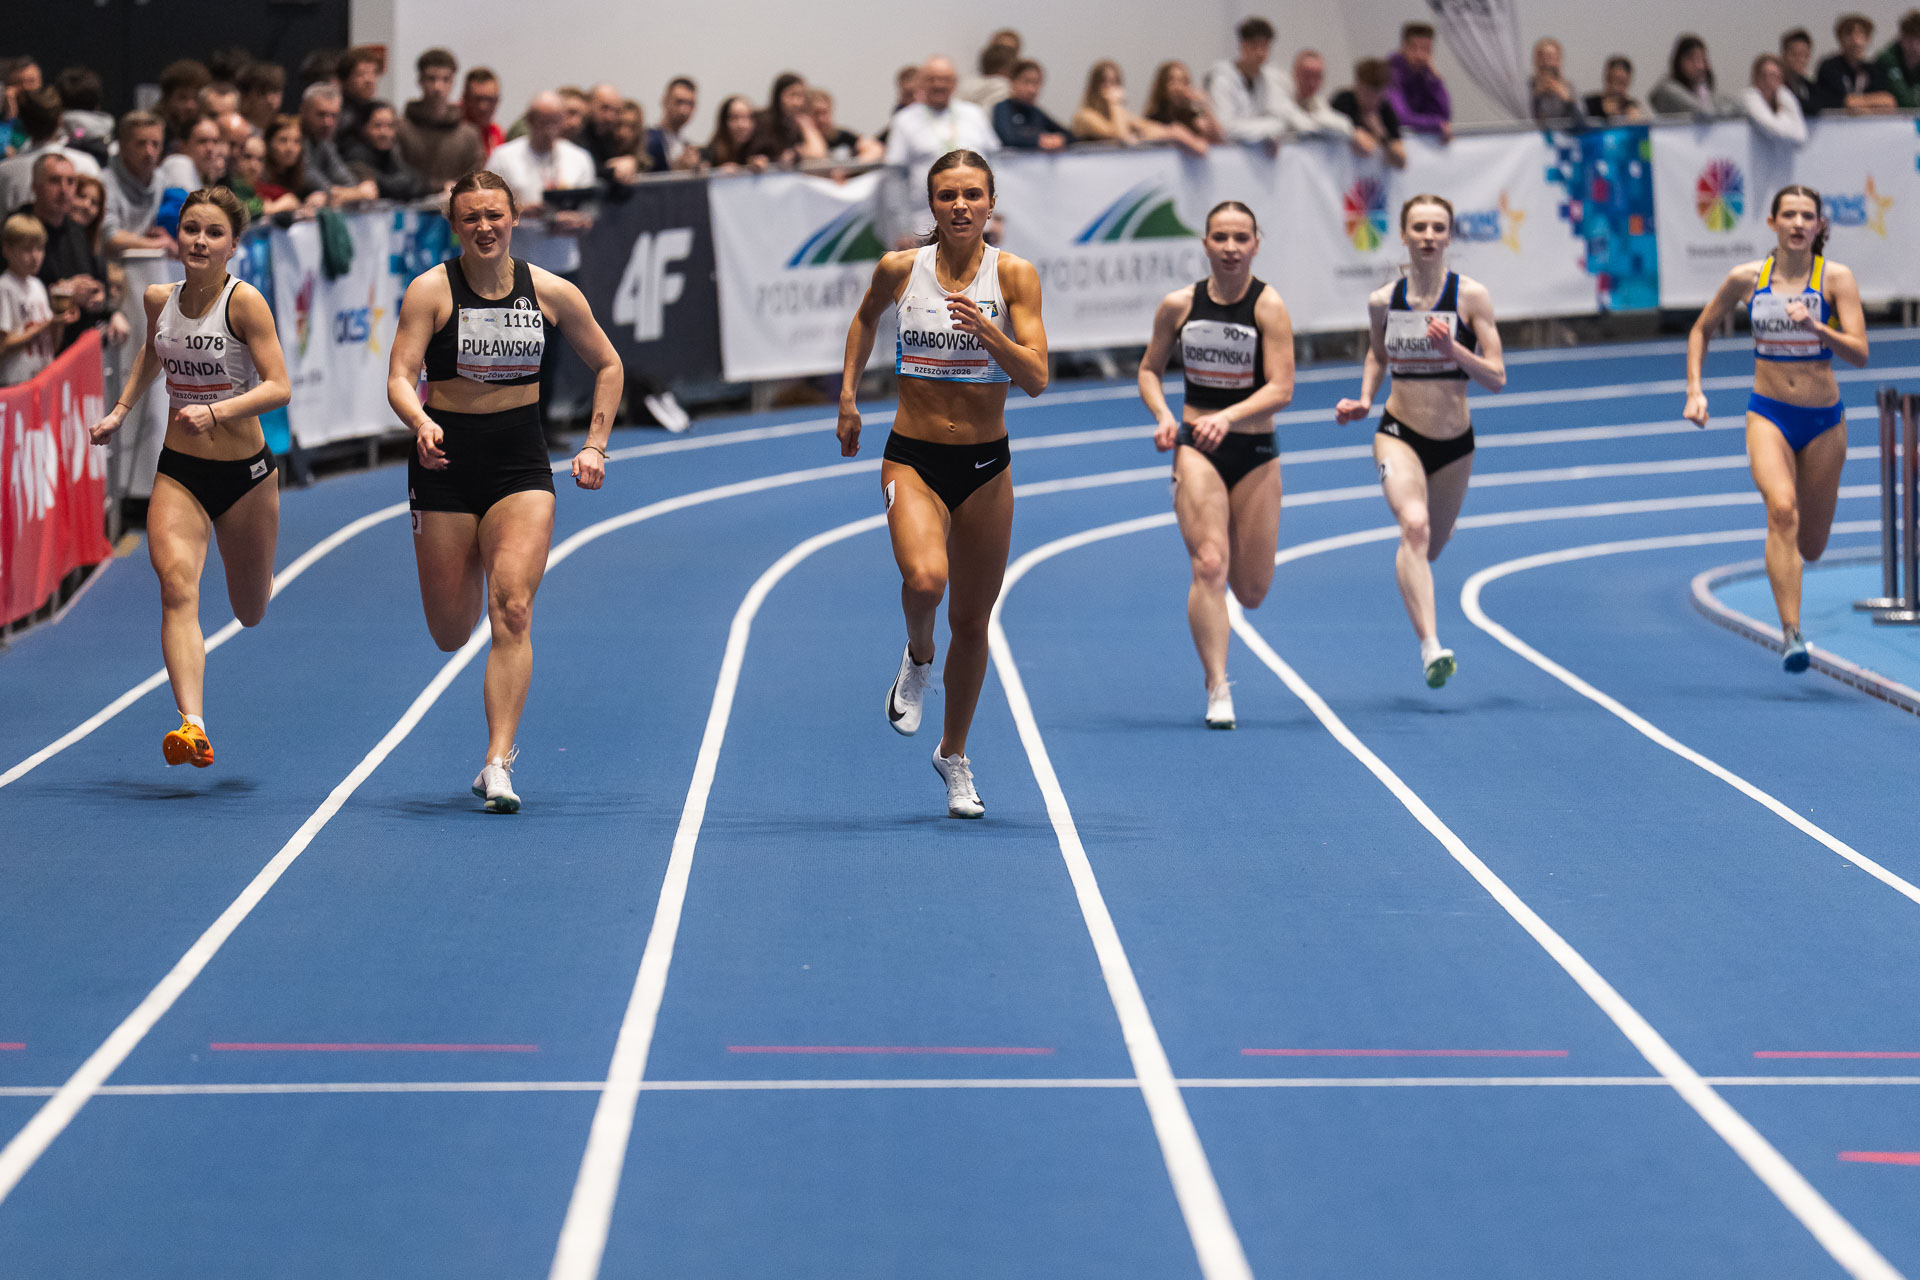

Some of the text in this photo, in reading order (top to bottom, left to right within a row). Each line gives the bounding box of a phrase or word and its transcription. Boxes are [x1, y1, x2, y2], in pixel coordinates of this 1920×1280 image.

[612, 227, 694, 342] 4F
[503, 312, 541, 328] 1116
[184, 335, 224, 351] 1078
[462, 338, 541, 357] PUŁAWSKA
[903, 329, 985, 351] GRABOWSKA
[914, 366, 972, 376] RZESZÓW 2026
